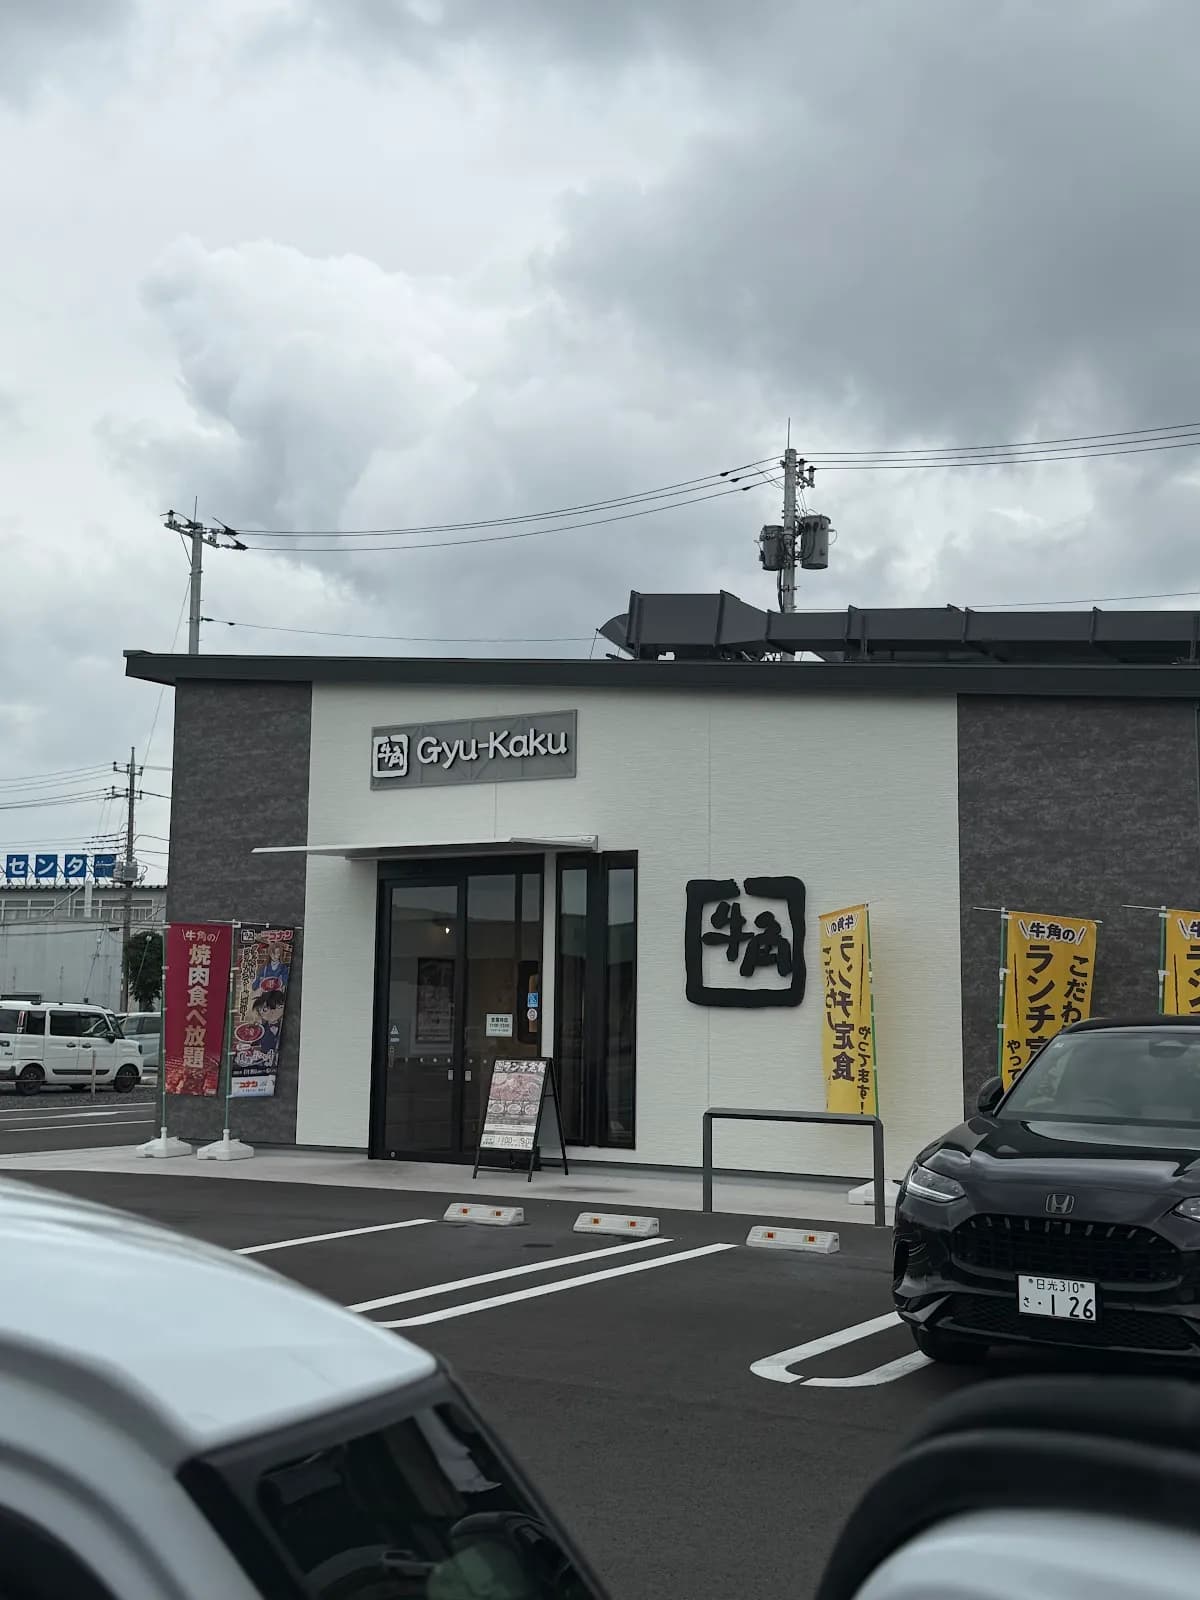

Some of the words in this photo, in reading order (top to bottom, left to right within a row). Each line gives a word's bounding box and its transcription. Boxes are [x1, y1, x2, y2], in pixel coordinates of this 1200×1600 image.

[417, 728, 567, 769] Gyu-Kaku
[185, 929, 216, 942] 牛角の
[701, 901, 793, 977] 牛角
[1029, 922, 1076, 942] 牛角の
[183, 943, 212, 1069] 焼肉食べ放題
[1060, 955, 1089, 1028] こだわ
